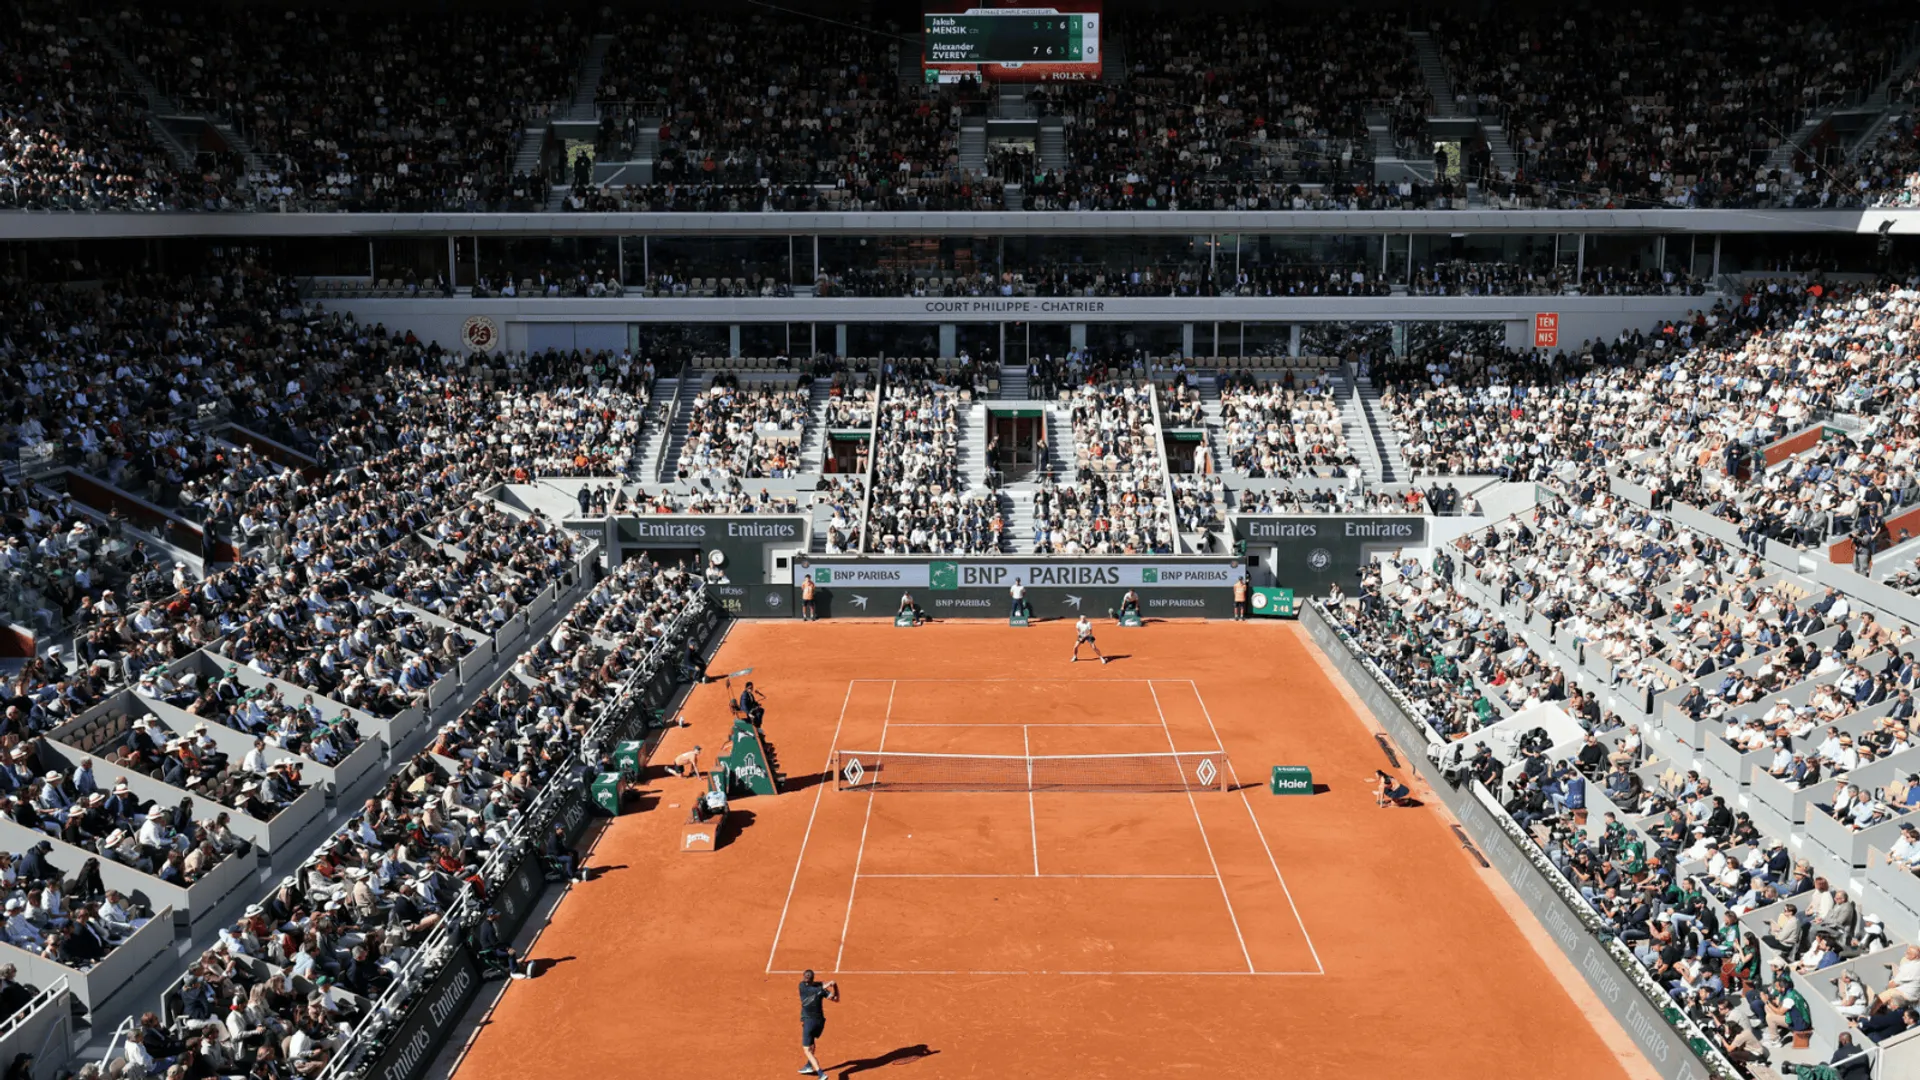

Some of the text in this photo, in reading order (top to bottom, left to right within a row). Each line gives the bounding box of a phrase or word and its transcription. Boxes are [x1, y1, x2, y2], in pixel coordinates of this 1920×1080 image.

[932, 18, 956, 26] Jakub
[1059, 21, 1066, 30] 6
[1087, 21, 1094, 29] 0
[932, 26, 967, 34] MENSIK
[932, 43, 974, 51] Alexander
[1033, 46, 1039, 55] 7
[1046, 46, 1053, 54] 6
[1072, 46, 1079, 54] 4
[1087, 46, 1094, 54] 0
[932, 51, 967, 59] ZVEREV
[1052, 72, 1086, 80] ROLEX
[925, 302, 968, 312] COURT
[973, 302, 1030, 312] PHILIPPE
[1041, 301, 1104, 312] CHATRIER
[1539, 316, 1555, 327] TEN
[1538, 332, 1554, 343] NIS
[639, 521, 795, 537] Emirates Emirates
[1249, 521, 1412, 537] Emirates Emirates
[834, 571, 901, 580] BNP PARIBAS
[963, 567, 1120, 585] BNP PARIBAS
[1161, 571, 1228, 580] BNP PARIBAS
[722, 599, 742, 610] 184
[935, 599, 992, 607] BNP PARIBAS
[1149, 599, 1205, 607] BNP PARIBAS
[1278, 778, 1308, 789] Haier
[1544, 901, 1579, 952] Emirates
[1582, 947, 1621, 1004] Emirates
[428, 966, 471, 1028] Emirates
[1625, 1000, 1670, 1063] Emirates
[383, 1024, 431, 1080] Emirates
